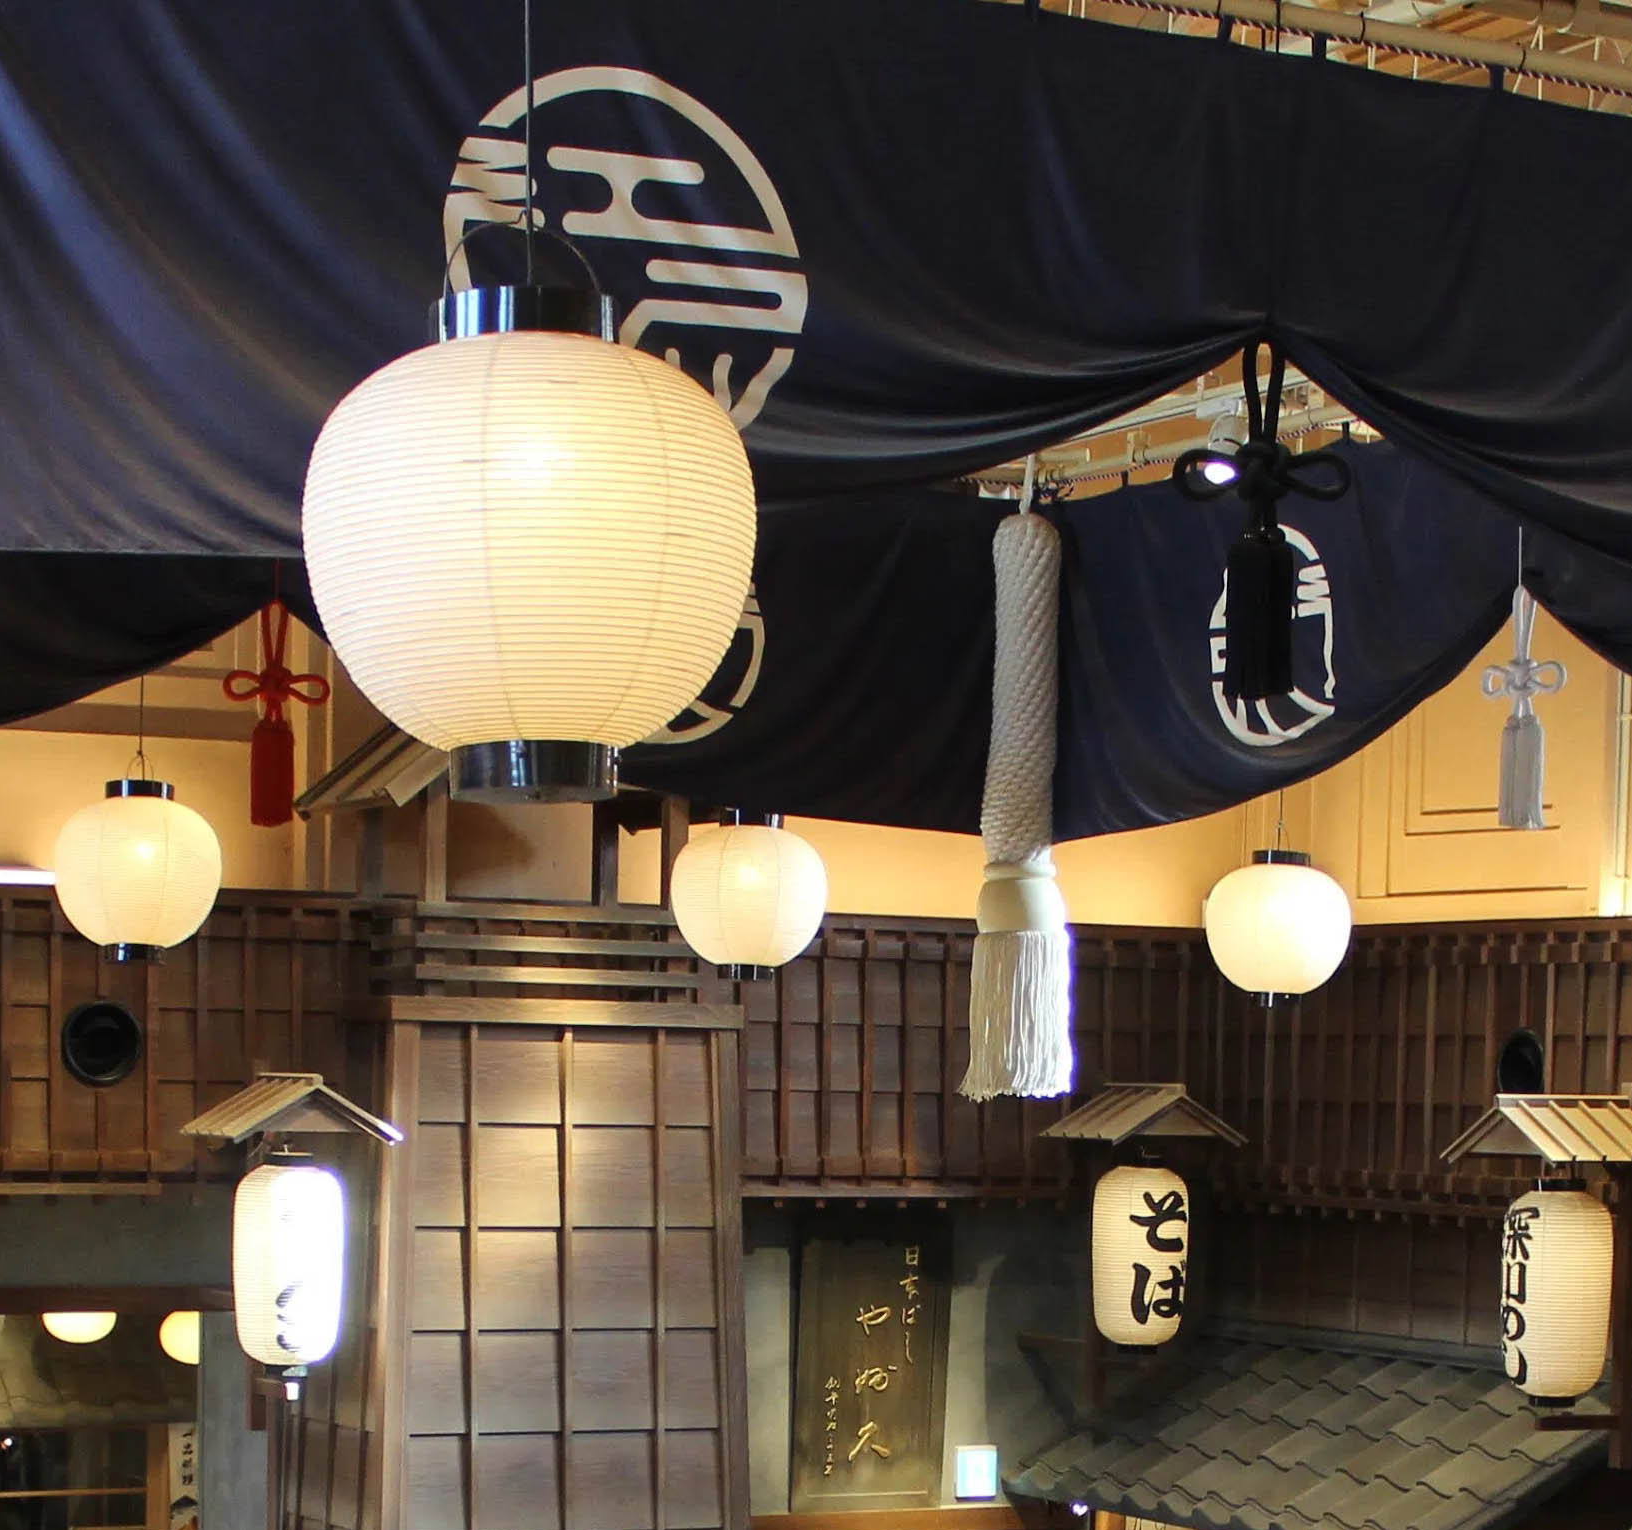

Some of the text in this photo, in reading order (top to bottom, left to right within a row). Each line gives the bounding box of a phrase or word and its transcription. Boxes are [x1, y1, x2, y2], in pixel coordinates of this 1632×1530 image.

[1130, 1191, 1188, 1325] そば
[848, 1305, 898, 1462] やぶ久
